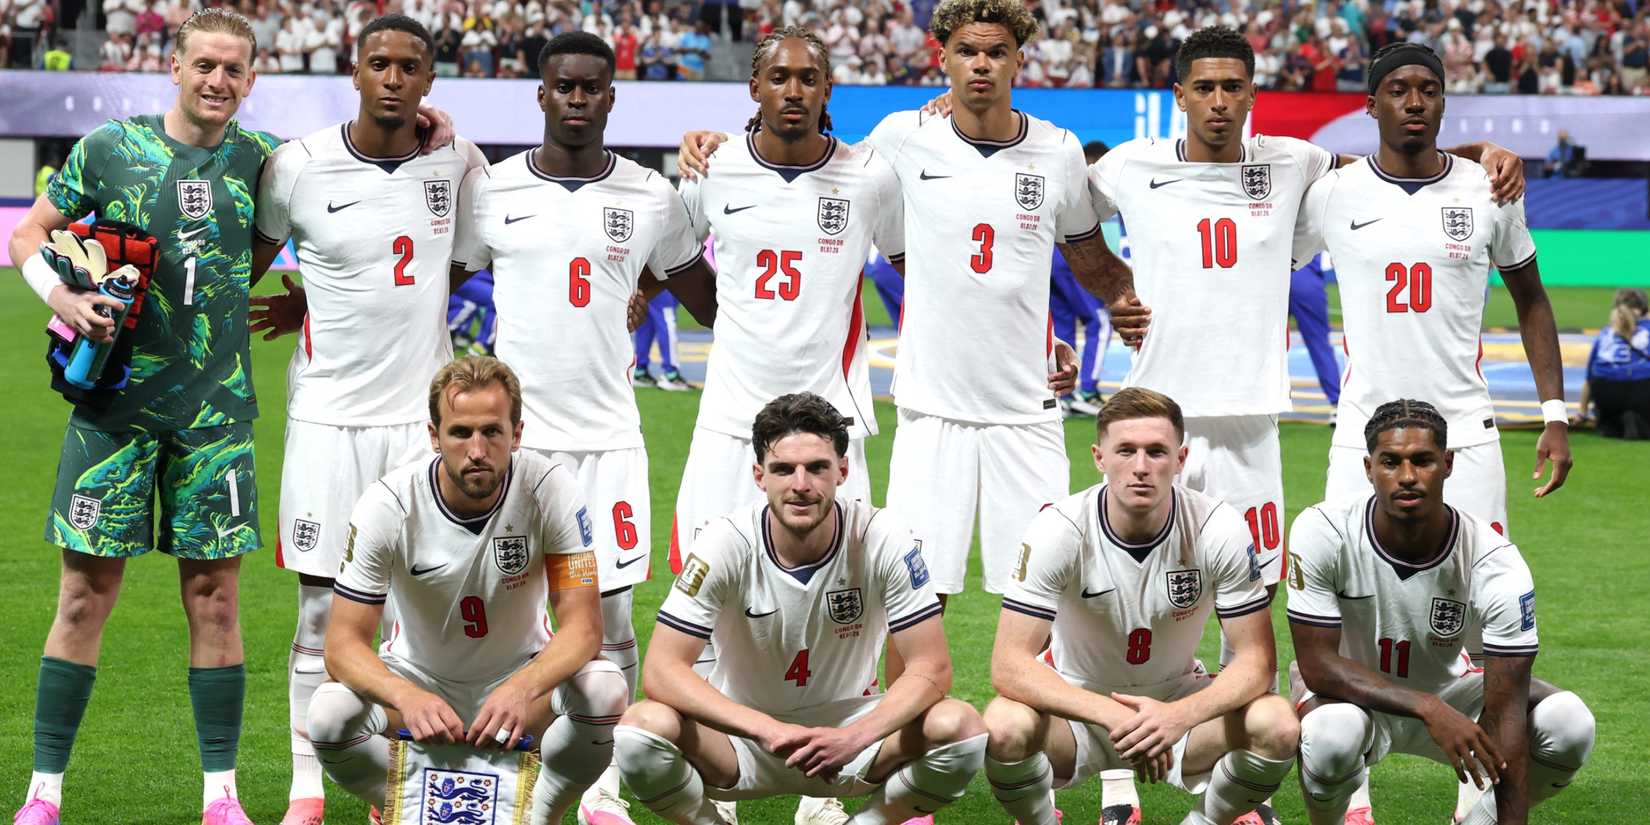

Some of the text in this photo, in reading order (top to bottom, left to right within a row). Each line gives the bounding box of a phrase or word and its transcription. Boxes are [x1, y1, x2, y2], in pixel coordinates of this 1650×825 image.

[393, 236, 415, 286] 2
[970, 223, 995, 273] 3
[1197, 218, 1237, 269] 10
[184, 256, 196, 305] 1
[569, 257, 591, 307] 6
[755, 249, 802, 301] 25
[1385, 262, 1432, 313] 20
[226, 469, 240, 517] 1
[612, 501, 638, 550] 6
[1244, 501, 1280, 554] 10
[460, 596, 488, 638] 9
[784, 648, 811, 687] 4
[1126, 628, 1152, 665] 8
[1379, 638, 1411, 678] 11
